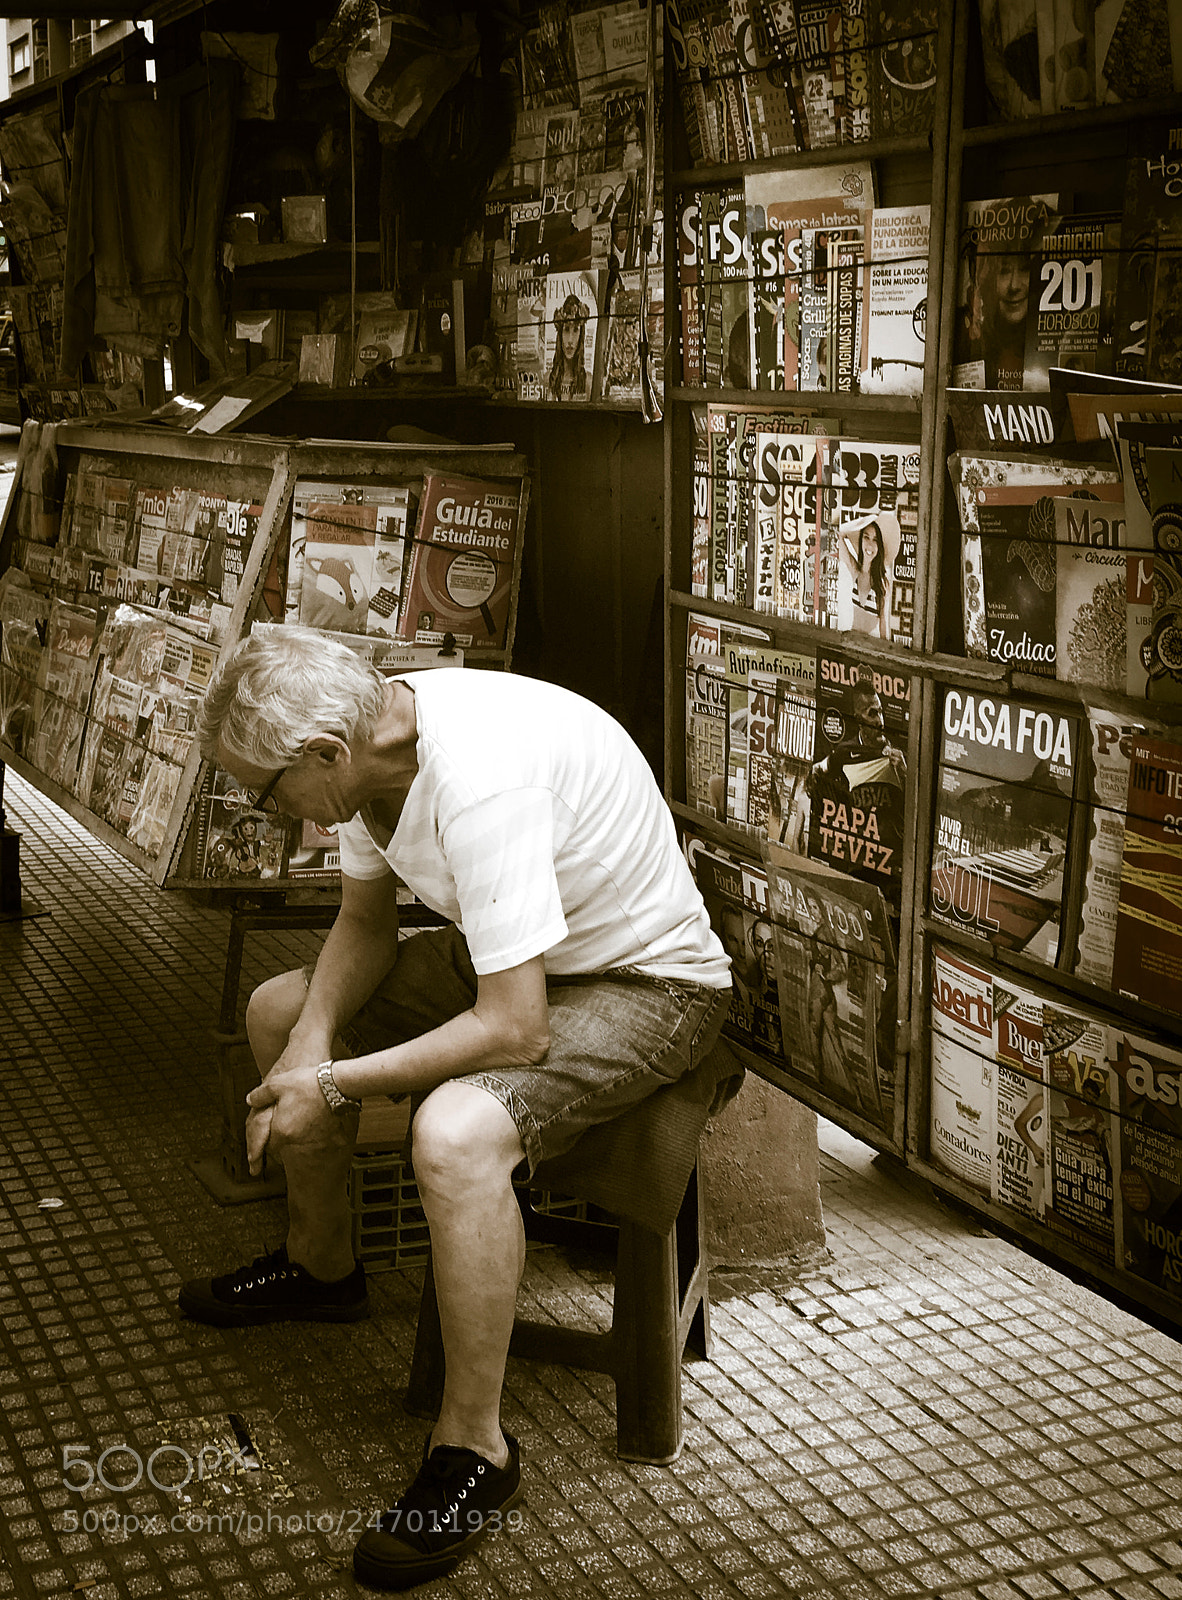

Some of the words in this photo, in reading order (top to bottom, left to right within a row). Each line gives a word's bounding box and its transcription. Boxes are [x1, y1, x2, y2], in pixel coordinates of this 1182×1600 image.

[874, 215, 921, 228] BIBLIOTECA
[873, 240, 884, 249] DE
[885, 240, 896, 249] LA
[872, 269, 891, 277] SOBRE
[893, 268, 901, 276] LA
[872, 279, 880, 287] EN
[882, 279, 892, 287] UN
[893, 277, 920, 286] MUNDO
[841, 271, 854, 308] SOPAS
[840, 310, 852, 326] DE
[839, 328, 852, 375] PAGINAS
[983, 404, 1055, 444] MAND
[436, 497, 493, 530] Guía
[493, 517, 512, 531] del
[432, 526, 510, 550] Estudiante
[715, 529, 728, 583] SOPAS
[758, 517, 776, 597] Extra
[820, 658, 860, 688] SOLO
[944, 690, 1012, 751] CASA
[1016, 707, 1073, 767] FOA
[1135, 747, 1150, 760] MIT
[820, 798, 881, 842] PAPÁ
[940, 814, 962, 838] VIVIR
[819, 826, 894, 876] TEVEZ
[938, 829, 960, 853] BAJO
[960, 837, 972, 858] EL
[932, 850, 1001, 933] SOL
[934, 1118, 992, 1165] Contadores
[997, 1131, 1029, 1160] DIETA
[997, 1147, 1029, 1174] ANTI
[1055, 1163, 1084, 1187] tener
[1056, 1179, 1069, 1197] en
[1084, 1193, 1107, 1213] mar
